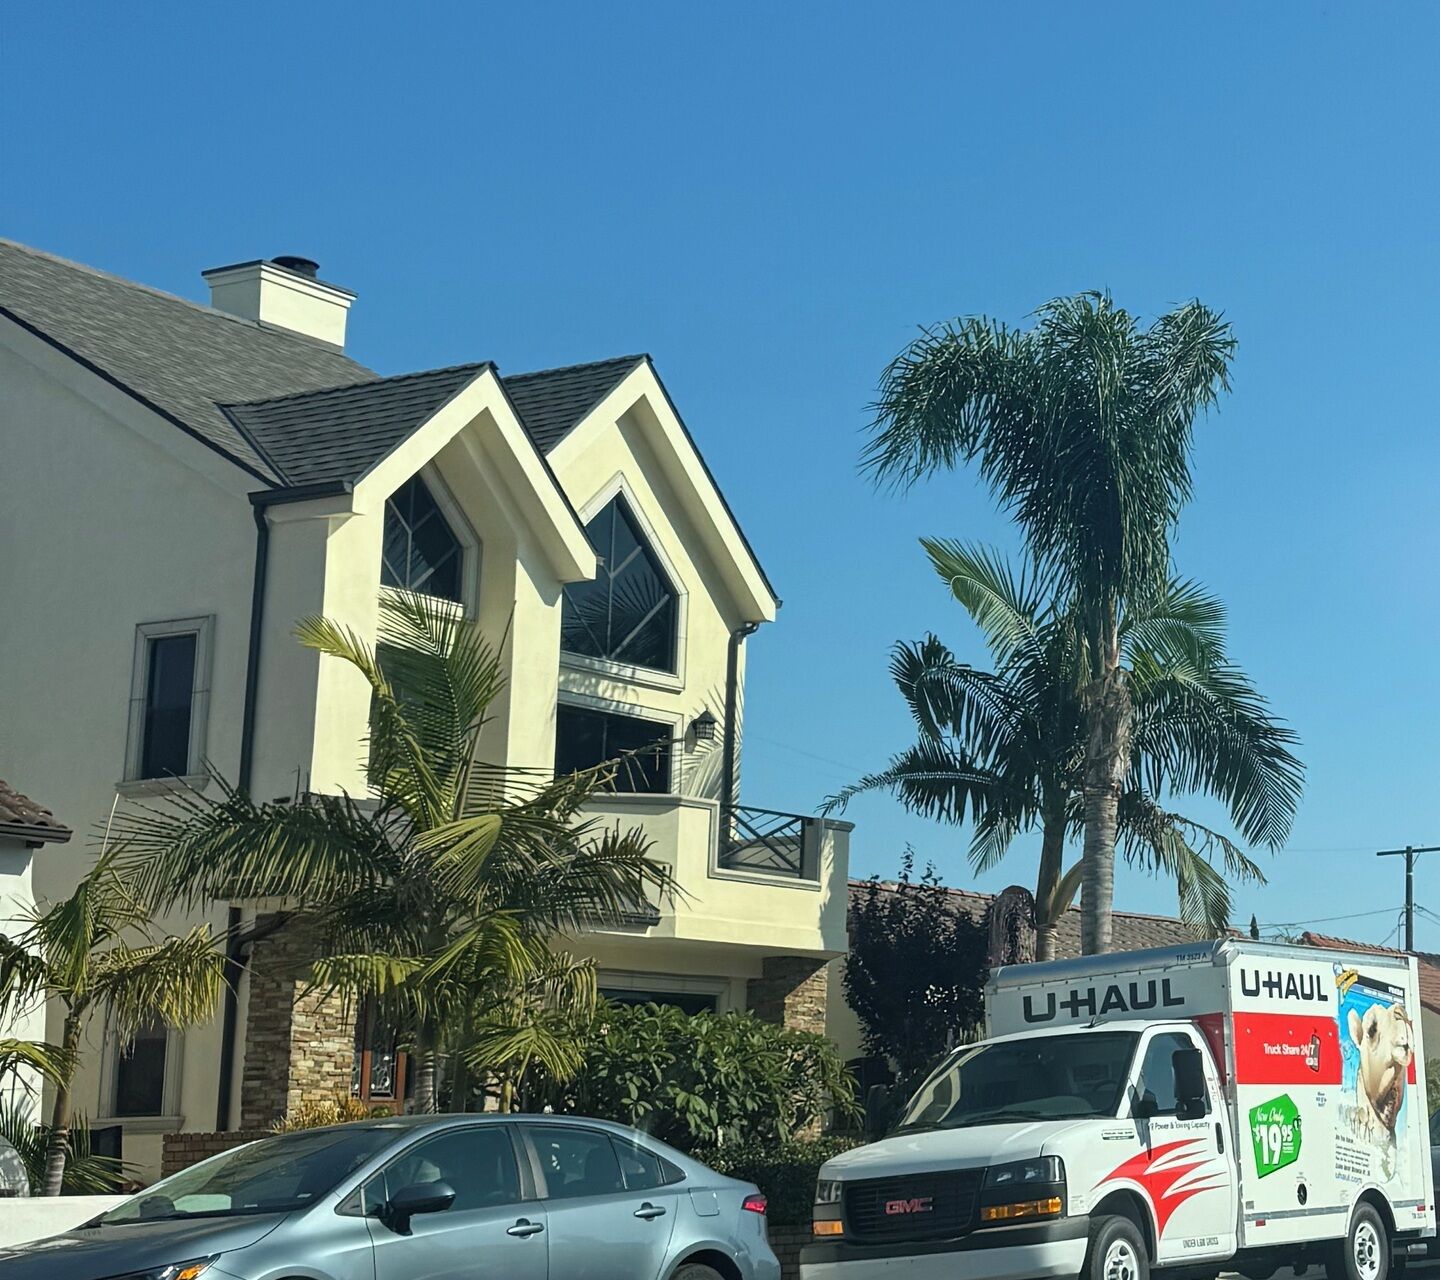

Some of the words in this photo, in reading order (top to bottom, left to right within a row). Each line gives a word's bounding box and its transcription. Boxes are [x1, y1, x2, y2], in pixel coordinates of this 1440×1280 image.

[1240, 969, 1328, 1002] U-HAUL
[1023, 978, 1184, 1023] U-HAUL
[1264, 1043, 1281, 1055] Truck
[1282, 1044, 1299, 1055] Share
[1301, 1043, 1315, 1056] 24/7
[886, 1197, 933, 1215] GMC
